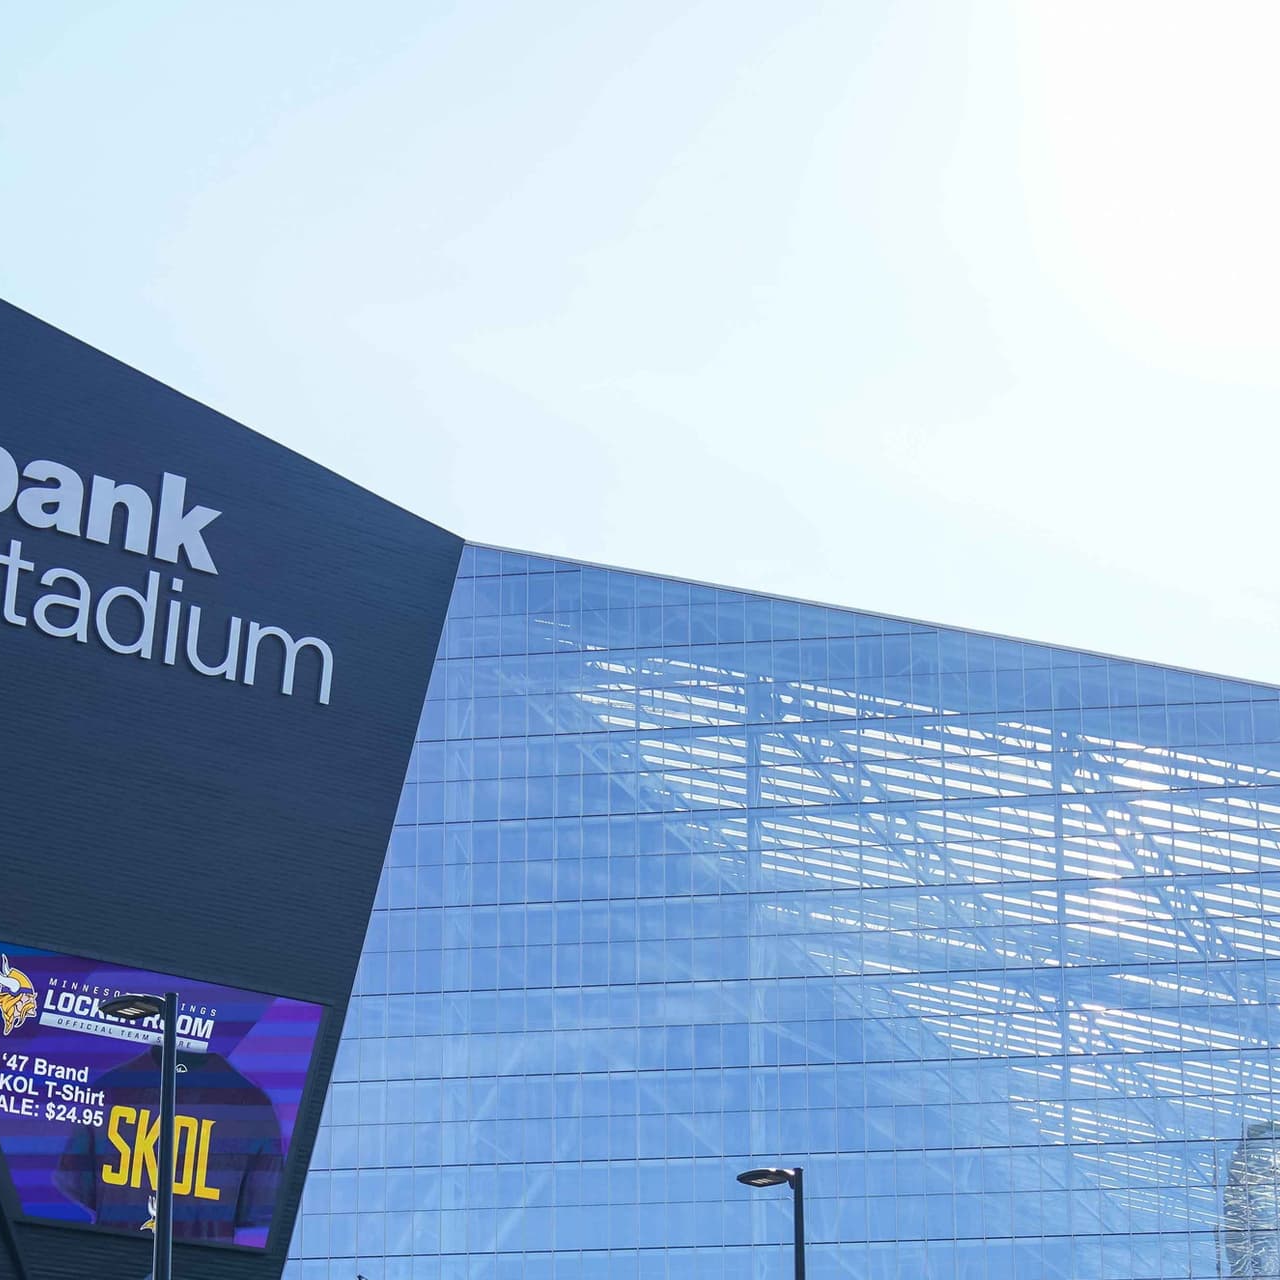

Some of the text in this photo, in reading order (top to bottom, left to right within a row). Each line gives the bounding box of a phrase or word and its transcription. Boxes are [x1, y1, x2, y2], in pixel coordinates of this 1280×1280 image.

[43, 988, 136, 1021] LOCK
[48, 977, 217, 1017] MINNESO INGS
[57, 1018, 192, 1049] OFFICIAL TEAM SRE
[33, 1057, 89, 1083] Brand
[45, 1080, 105, 1107] T-Shirt
[45, 1101, 104, 1128] $24.95
